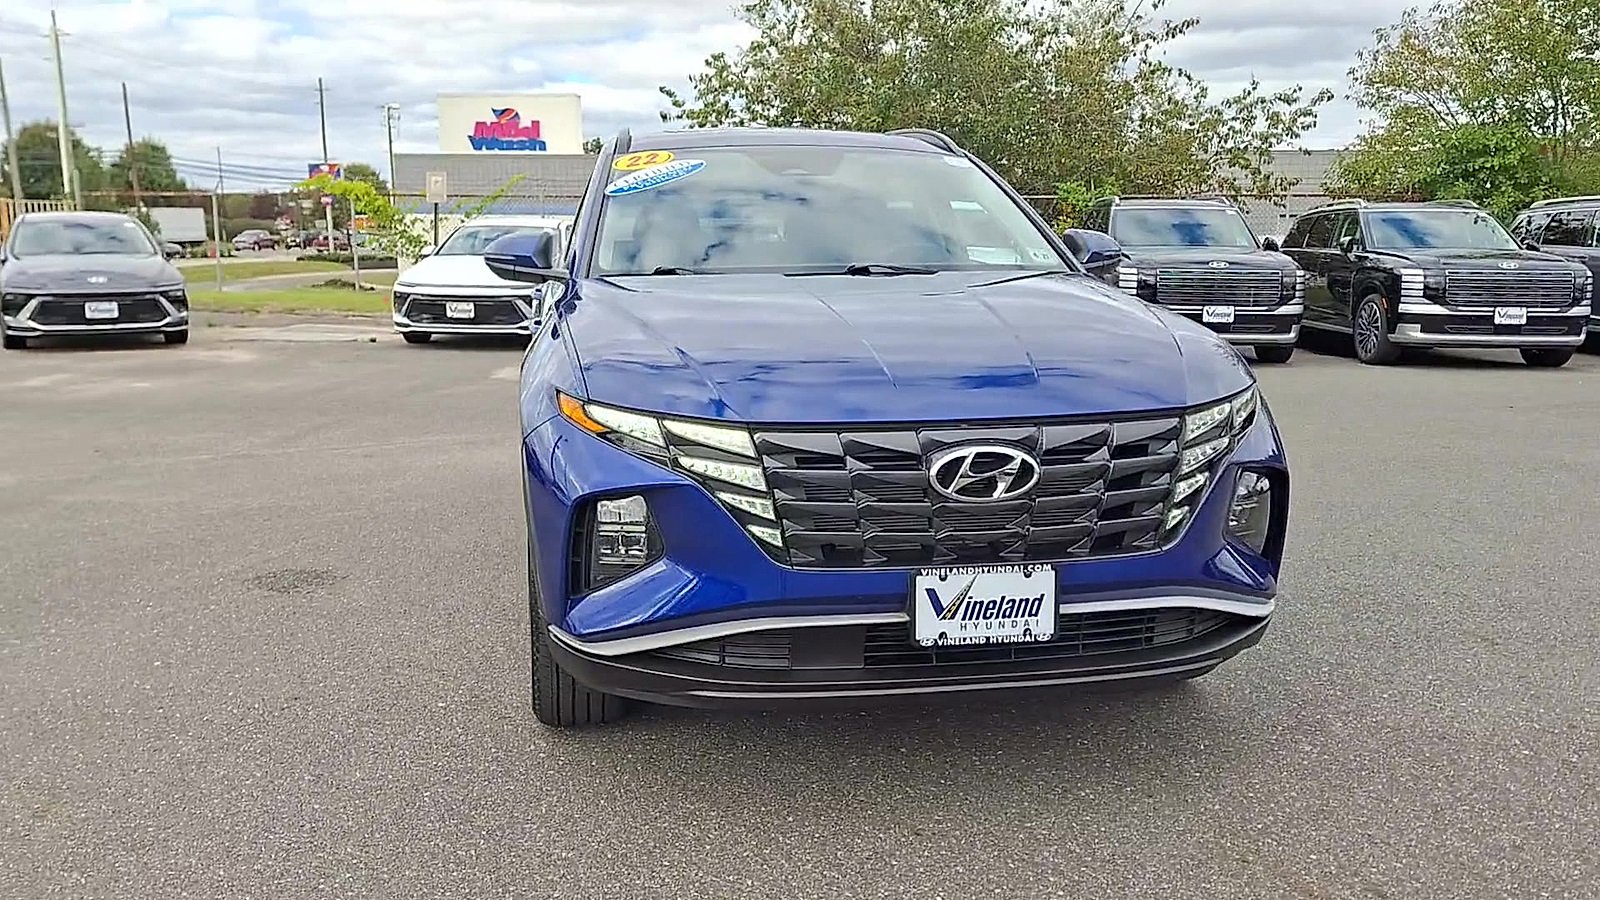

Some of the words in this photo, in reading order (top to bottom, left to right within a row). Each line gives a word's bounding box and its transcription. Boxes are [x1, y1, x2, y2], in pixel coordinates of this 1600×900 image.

[626, 153, 659, 167] 22
[920, 564, 1052, 577] VINELANDHYUNDAI.COM
[925, 574, 1046, 622] Vineland
[960, 619, 1040, 631] HYUNDAI
[937, 636, 987, 647] VINELAND
[990, 634, 1035, 644] HYUNDAI
